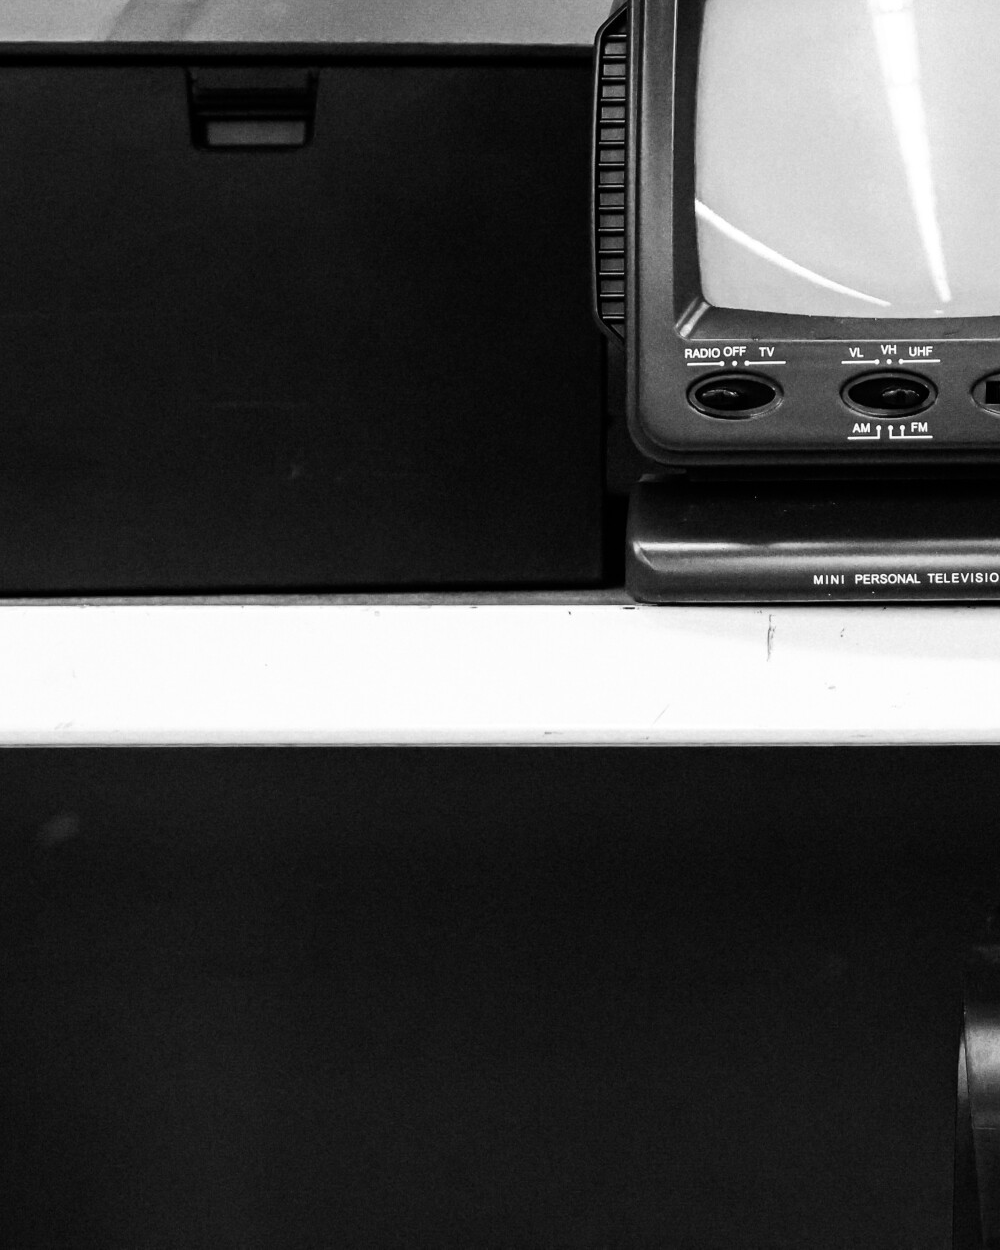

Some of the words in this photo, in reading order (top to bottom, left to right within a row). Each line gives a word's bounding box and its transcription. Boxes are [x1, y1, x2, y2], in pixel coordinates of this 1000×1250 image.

[684, 347, 721, 359] RADIO
[722, 345, 747, 357] OFF
[758, 346, 775, 358] TV
[848, 347, 864, 358] VL
[880, 344, 897, 355] VH
[908, 345, 934, 358] UHF
[852, 422, 871, 434] AM
[910, 421, 928, 433] FM
[813, 574, 845, 585] MINI
[854, 573, 921, 585] PERSONAL
